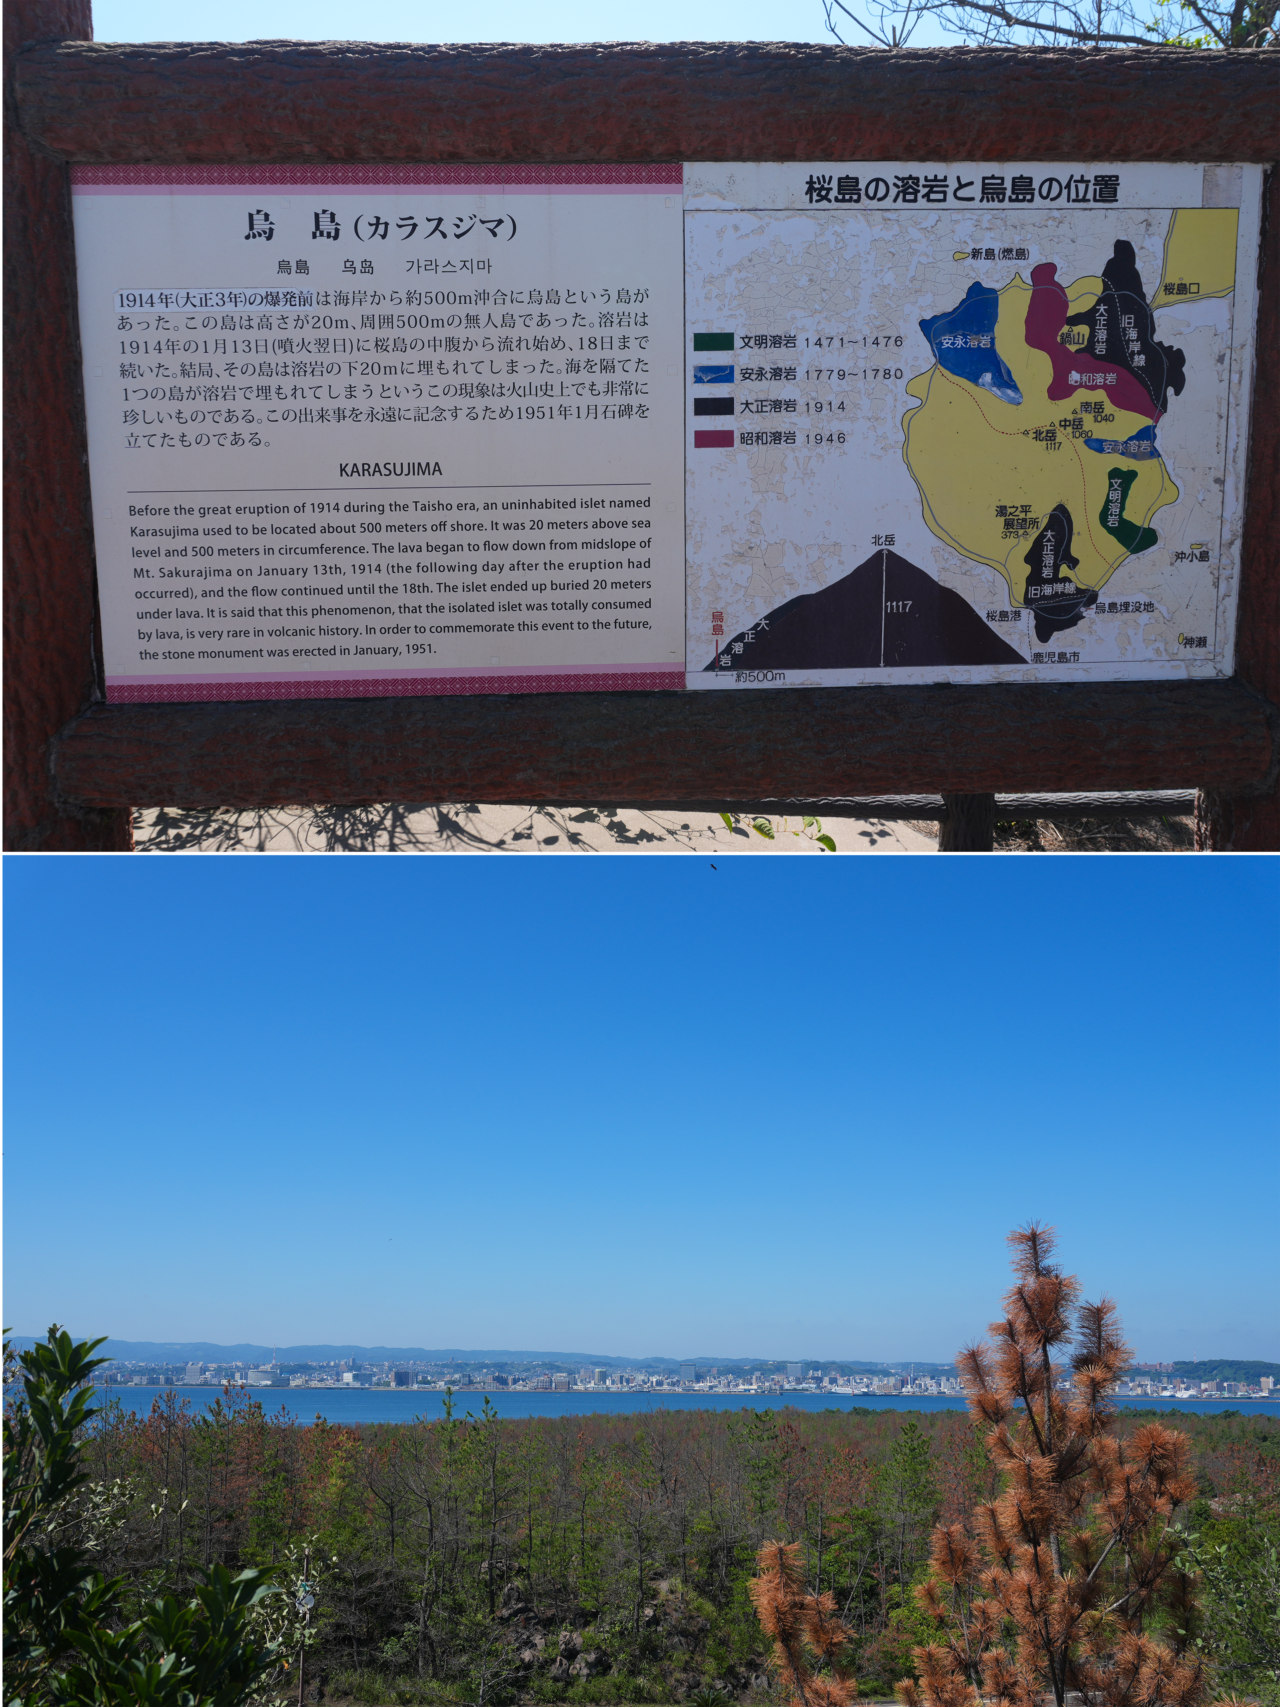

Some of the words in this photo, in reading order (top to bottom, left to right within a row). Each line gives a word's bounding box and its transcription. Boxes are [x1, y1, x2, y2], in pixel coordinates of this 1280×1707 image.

[804, 173, 1120, 204] 桜島の溶岩と烏島の位置
[341, 258, 375, 276] 乌岛
[405, 257, 493, 275] 가라스지마
[1163, 282, 1200, 296] 桜島口
[1094, 304, 1108, 355] 大正溶岩
[739, 334, 797, 349] 文明溶岩
[940, 335, 992, 349] 安永溶岩
[1059, 331, 1085, 346] 鍋山
[1121, 315, 1146, 367] 旧海岸線
[739, 366, 797, 382] 安永溶岩
[739, 398, 797, 414] 大正溶岩
[805, 401, 846, 413] 1914
[1079, 401, 1105, 414] 南岳
[1058, 417, 1084, 431] 中岳
[1093, 413, 1115, 423] 1040
[124, 430, 272, 449] 立てたものである。
[739, 431, 797, 446] 昭和溶岩
[805, 432, 846, 445] 1946
[1031, 429, 1057, 442] 北岳
[1071, 429, 1093, 439] 1060
[1045, 441, 1062, 451] 1117
[1102, 440, 1151, 453] 安永溶岩
[339, 461, 443, 477] KARASUJIMA
[128, 504, 170, 516] Before
[172, 503, 194, 515] the
[197, 504, 232, 518] great
[234, 502, 289, 517] eruption
[292, 501, 306, 513] of
[309, 501, 340, 513] 1914
[343, 501, 385, 515] during
[388, 500, 409, 512] the
[411, 499, 453, 511] Taisho
[455, 502, 479, 512] era,
[482, 501, 497, 510] an
[501, 497, 576, 510] uninhabited
[580, 497, 605, 509] islet
[608, 495, 650, 508] named
[1106, 478, 1122, 527] 文明溶岩
[995, 505, 1032, 518] 湯之平
[129, 525, 199, 539] Karasujima
[202, 523, 232, 536] used
[234, 525, 248, 535] to
[251, 523, 267, 535] be
[270, 522, 316, 535] located
[319, 522, 356, 534] about
[359, 521, 382, 533] 500
[385, 522, 427, 532] meters
[430, 520, 447, 532] off
[449, 520, 487, 532] shore.
[490, 519, 499, 531] It
[501, 521, 526, 530] was
[528, 519, 543, 530] 20
[546, 519, 588, 530] meters
[591, 517, 628, 529] above
[631, 519, 651, 528] sea
[1003, 517, 1040, 530] 展望所
[871, 534, 895, 547] 北岳
[1001, 530, 1019, 539] 373
[131, 546, 161, 558] level
[163, 545, 188, 557] and
[191, 545, 214, 557] 500
[217, 546, 260, 556] meters
[262, 544, 274, 555] in
[277, 542, 369, 555] circumference.
[371, 542, 394, 553] The
[397, 541, 422, 553] lava
[425, 541, 464, 555] began
[466, 541, 480, 552] to
[482, 539, 509, 551] flow
[511, 539, 546, 551] down
[548, 538, 577, 550] from
[581, 537, 636, 551] midslope
[638, 536, 652, 548] of
[1041, 530, 1056, 579] 大正溶岩
[1174, 550, 1210, 563] 沖小島
[133, 567, 154, 578] Mt.
[158, 566, 232, 580] Sakurajima
[236, 567, 253, 577] on
[256, 565, 308, 578] January
[312, 563, 346, 576] 13th,
[350, 563, 382, 574] 1914
[385, 562, 412, 575] (the
[415, 561, 477, 575] following
[481, 560, 505, 574] day
[508, 559, 539, 571] after
[542, 559, 564, 570] the
[567, 558, 623, 572] eruption
[627, 557, 650, 569] had
[134, 586, 197, 599] occurred),
[200, 586, 224, 598] and
[226, 585, 248, 597] the
[250, 585, 278, 597] flow
[280, 583, 343, 596] continued
[346, 583, 375, 595] until
[377, 582, 398, 594] the
[402, 581, 433, 594] 18th.
[435, 581, 458, 593] The
[461, 580, 487, 592] islet
[489, 579, 528, 592] ended
[531, 582, 547, 593] up
[550, 578, 589, 591] buried
[592, 578, 607, 590] 20
[610, 579, 651, 589] meters
[1027, 582, 1077, 599] 旧海岸線
[136, 607, 172, 620] under
[175, 607, 204, 619] lava.
[206, 607, 215, 618] It
[217, 607, 228, 618] is
[230, 605, 255, 617] said
[257, 605, 283, 617] that
[285, 605, 308, 616] this
[310, 604, 395, 618] phenomenon,
[397, 602, 422, 614] that
[424, 602, 445, 613] the
[448, 600, 495, 613] isolated
[497, 600, 522, 612] islet
[524, 602, 548, 611] was
[550, 598, 588, 613] totally
[590, 597, 651, 610] consumed
[886, 600, 912, 614] 1117
[1094, 601, 1154, 614] 烏島埋没地
[985, 609, 1021, 622] 桜島港
[711, 611, 724, 636] 烏島
[1182, 635, 1207, 649] 神瀬
[138, 648, 159, 660] the
[161, 649, 195, 659] stone
[197, 647, 264, 659] monument
[265, 648, 289, 657] was
[291, 644, 336, 657] erected
[339, 645, 350, 655] in
[352, 644, 402, 657] January,
[405, 643, 436, 654] 1951.
[1032, 651, 1080, 663] 鹿児島市
[734, 670, 786, 683] 約500m
